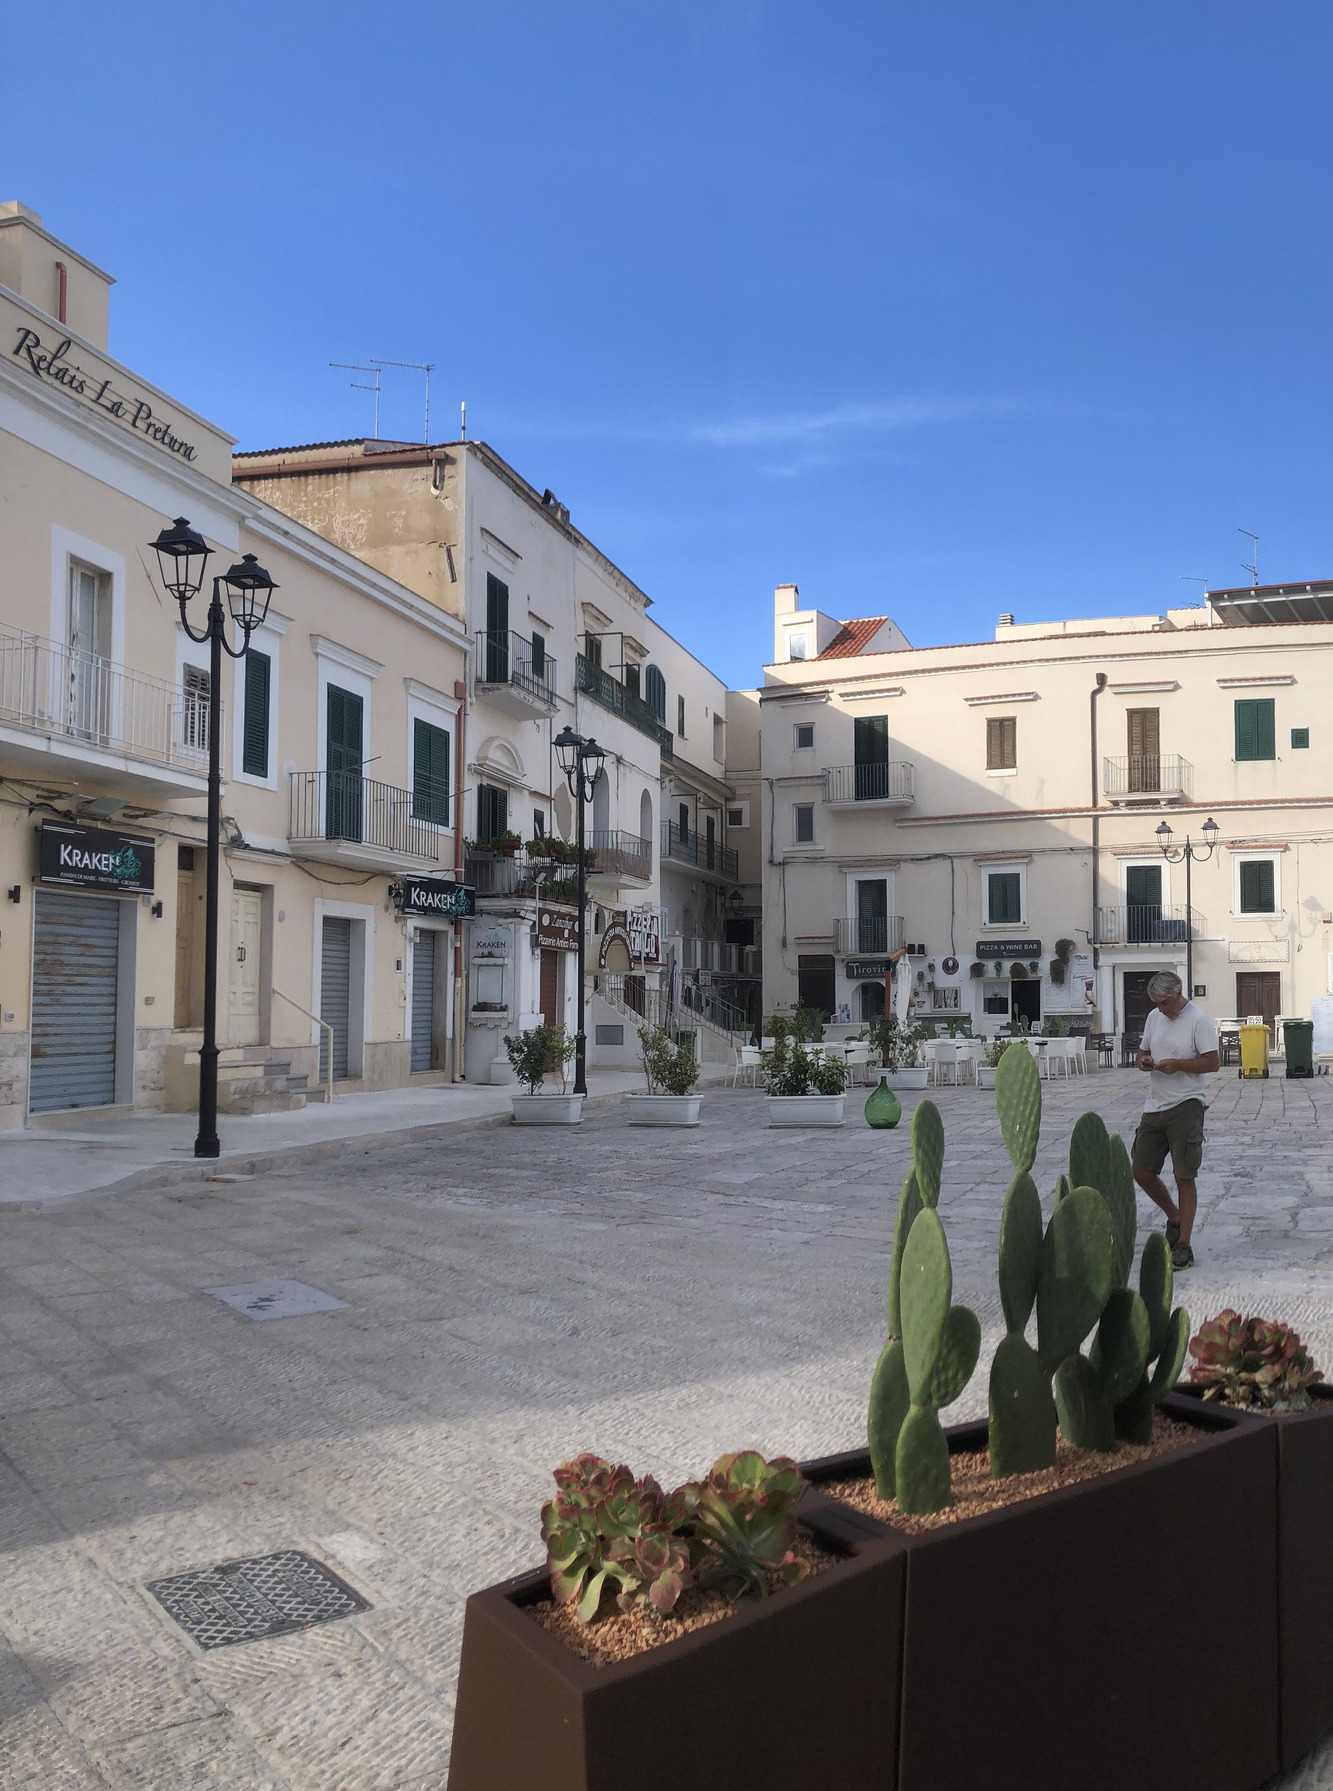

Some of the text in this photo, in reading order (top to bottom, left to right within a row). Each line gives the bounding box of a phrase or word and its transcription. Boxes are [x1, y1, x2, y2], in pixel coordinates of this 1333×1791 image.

[12, 327, 198, 462] Relais La Pretura
[60, 843, 120, 872] KRAKEN
[411, 886, 456, 909] KRAKEN
[476, 940, 506, 949] KRAKEN
[848, 962, 893, 977] Tirovin
